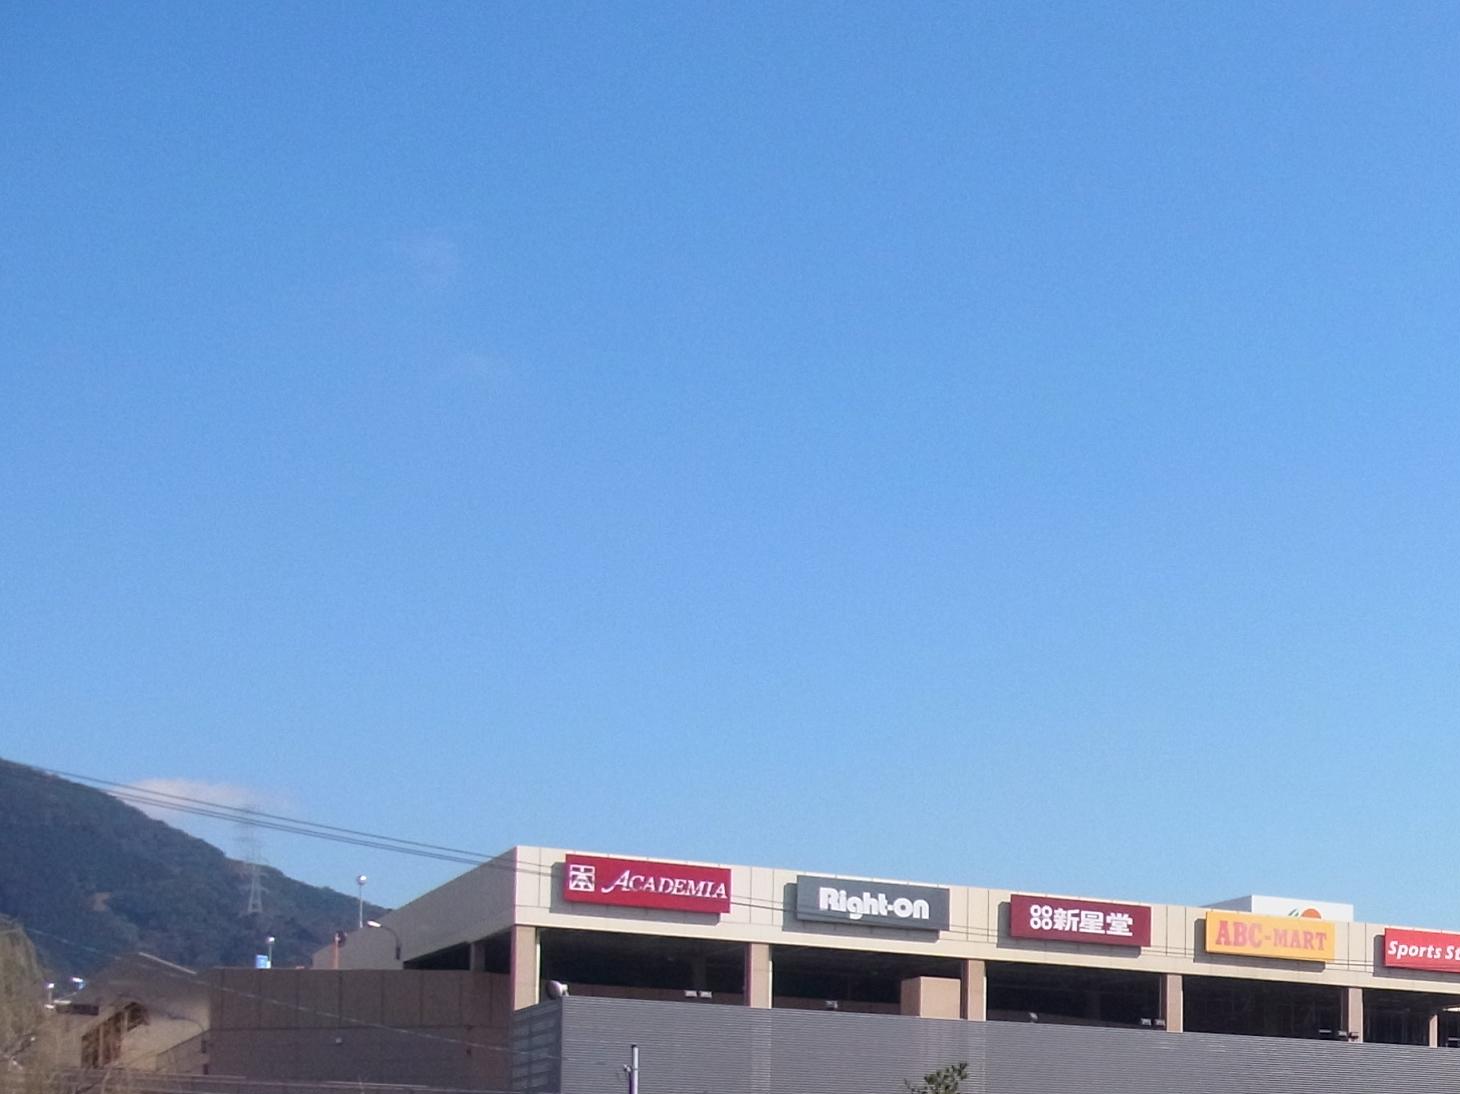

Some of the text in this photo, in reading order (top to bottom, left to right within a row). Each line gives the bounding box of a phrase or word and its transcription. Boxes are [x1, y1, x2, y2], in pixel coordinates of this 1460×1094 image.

[601, 870, 728, 899] ACADEMIA
[818, 886, 930, 920] Right-on
[1053, 907, 1134, 937] 新星堂
[1215, 919, 1328, 951] ABC-MART
[1387, 940, 1443, 960] Sports
